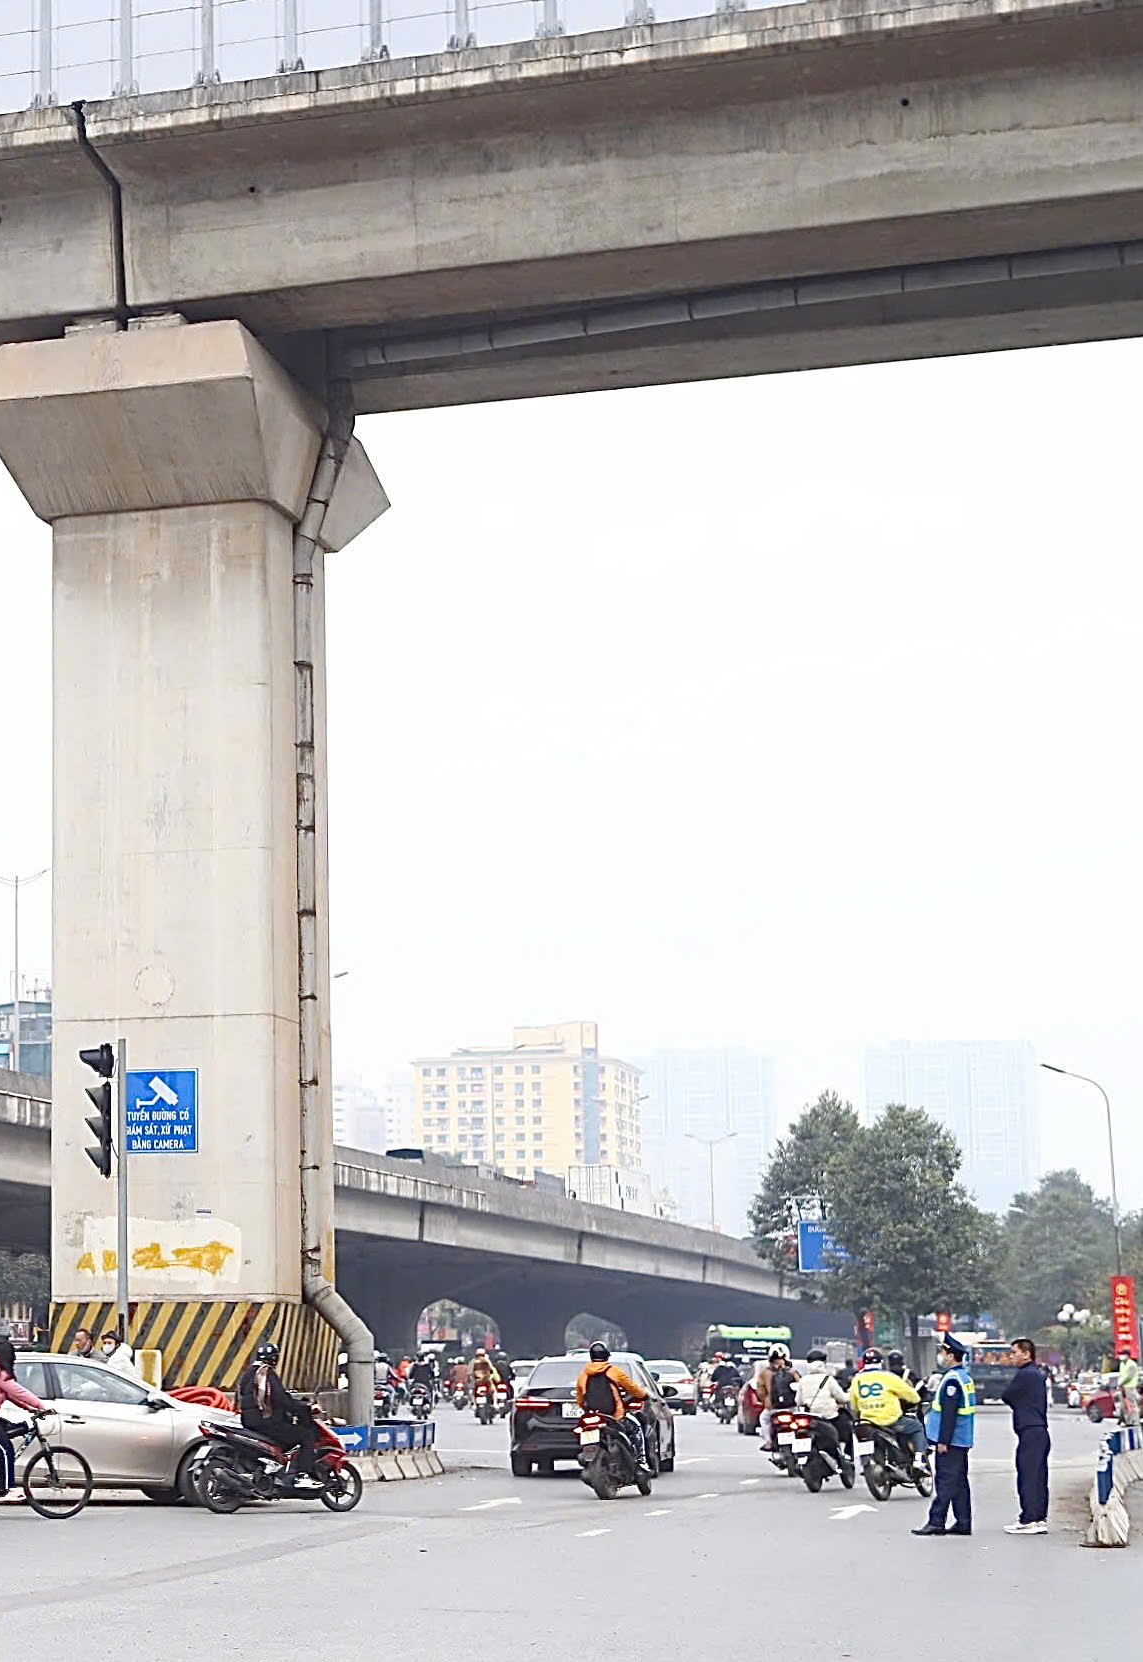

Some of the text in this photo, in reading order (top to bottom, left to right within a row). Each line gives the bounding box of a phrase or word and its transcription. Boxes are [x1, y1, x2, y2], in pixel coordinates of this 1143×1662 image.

[179, 1107, 189, 1121] CÓ
[154, 1139, 185, 1149] CAMERA
[858, 1380, 883, 1398] be
